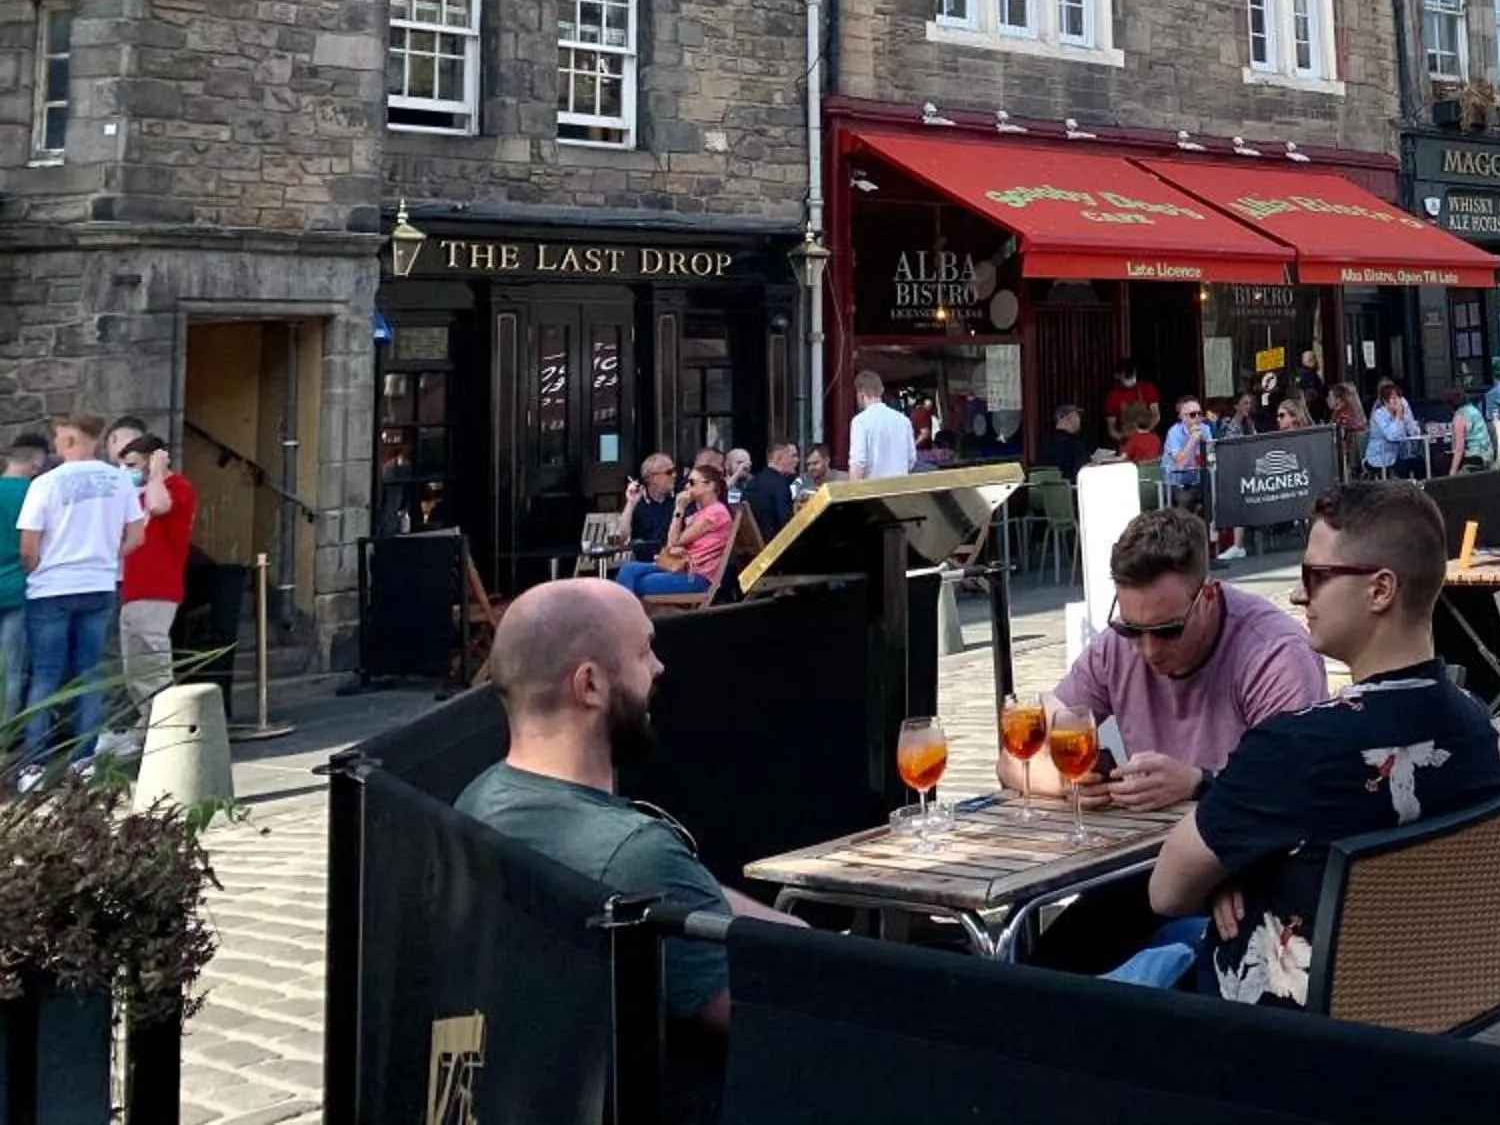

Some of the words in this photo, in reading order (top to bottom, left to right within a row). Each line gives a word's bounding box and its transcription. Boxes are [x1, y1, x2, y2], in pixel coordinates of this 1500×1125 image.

[1448, 196, 1493, 214] WHISKY
[1449, 215, 1471, 230] ALE
[441, 240, 520, 270] THE
[537, 244, 625, 273] LAST
[640, 248, 733, 276] DROP
[893, 249, 977, 282] ALBA
[1126, 261, 1155, 276] Late
[1397, 270, 1423, 285] Open
[895, 282, 979, 306] BISTRO
[1240, 469, 1309, 494] MAGNERS
